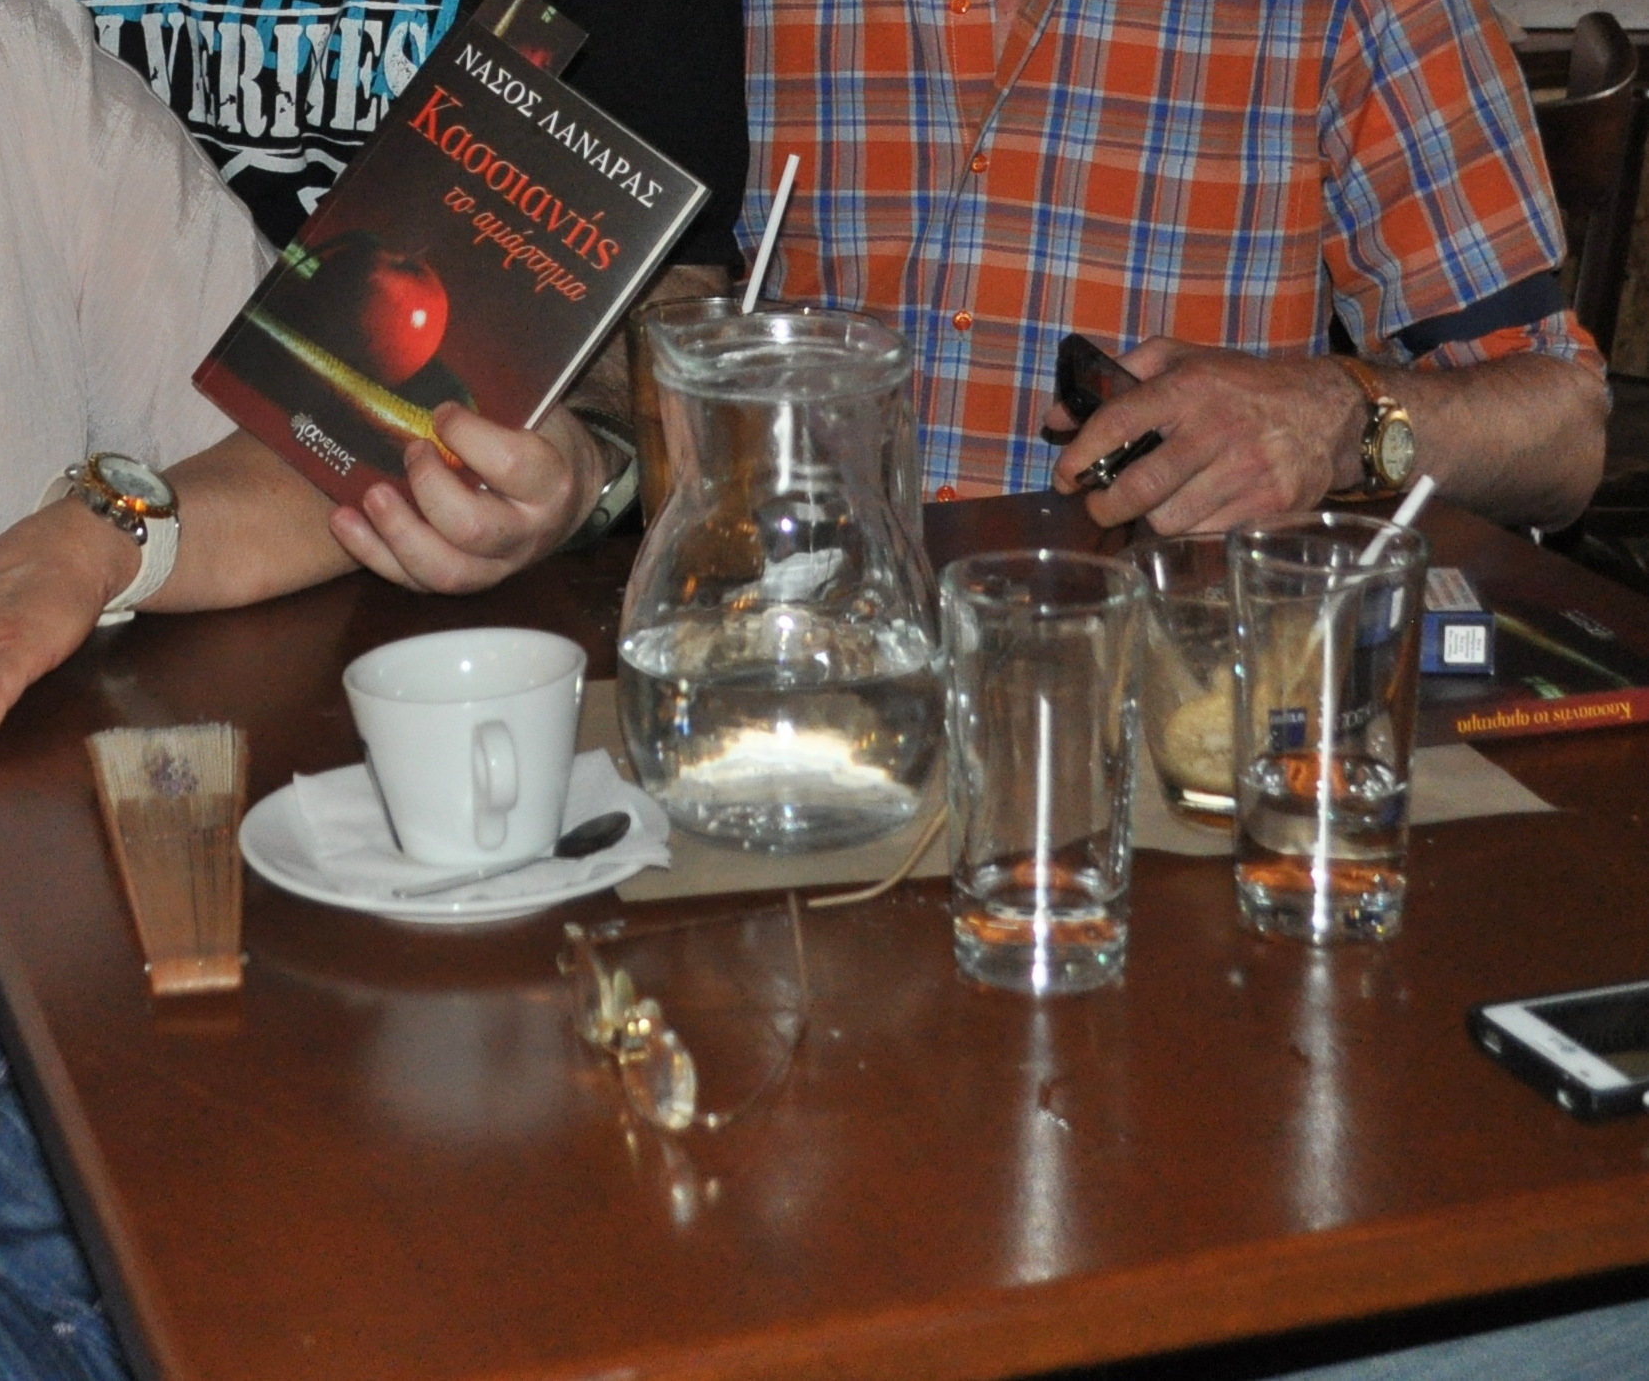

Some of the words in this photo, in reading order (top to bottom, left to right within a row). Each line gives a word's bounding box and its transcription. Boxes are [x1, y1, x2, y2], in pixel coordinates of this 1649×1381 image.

[408, 84, 620, 270] Κασσιανής
[455, 43, 542, 117] ΝΑΣΟΣ
[538, 110, 662, 208] ΛΑΝΑΡΑΣ
[444, 186, 475, 214] το
[473, 212, 587, 302] αμάρτημα
